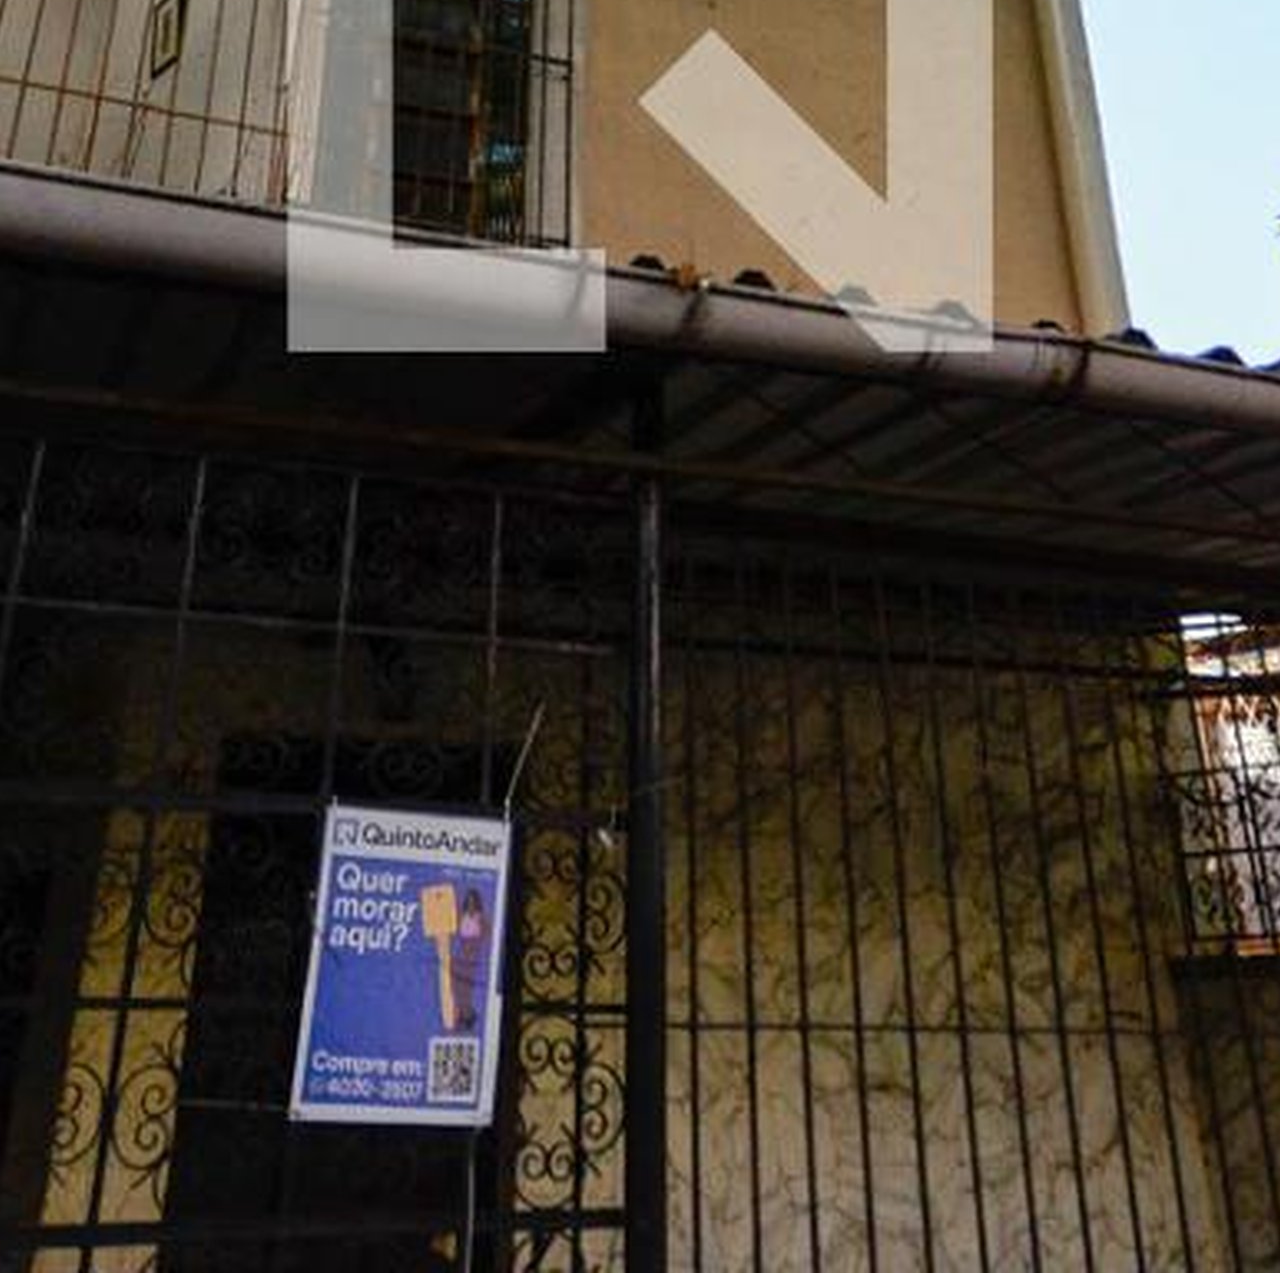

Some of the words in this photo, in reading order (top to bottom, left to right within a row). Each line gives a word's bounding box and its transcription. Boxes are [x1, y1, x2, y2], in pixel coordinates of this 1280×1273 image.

[362, 823, 501, 856] QuintoAndar
[337, 862, 410, 894] Quer
[333, 898, 418, 924] morar
[329, 922, 408, 955] aqui?
[312, 1049, 389, 1077] Compre
